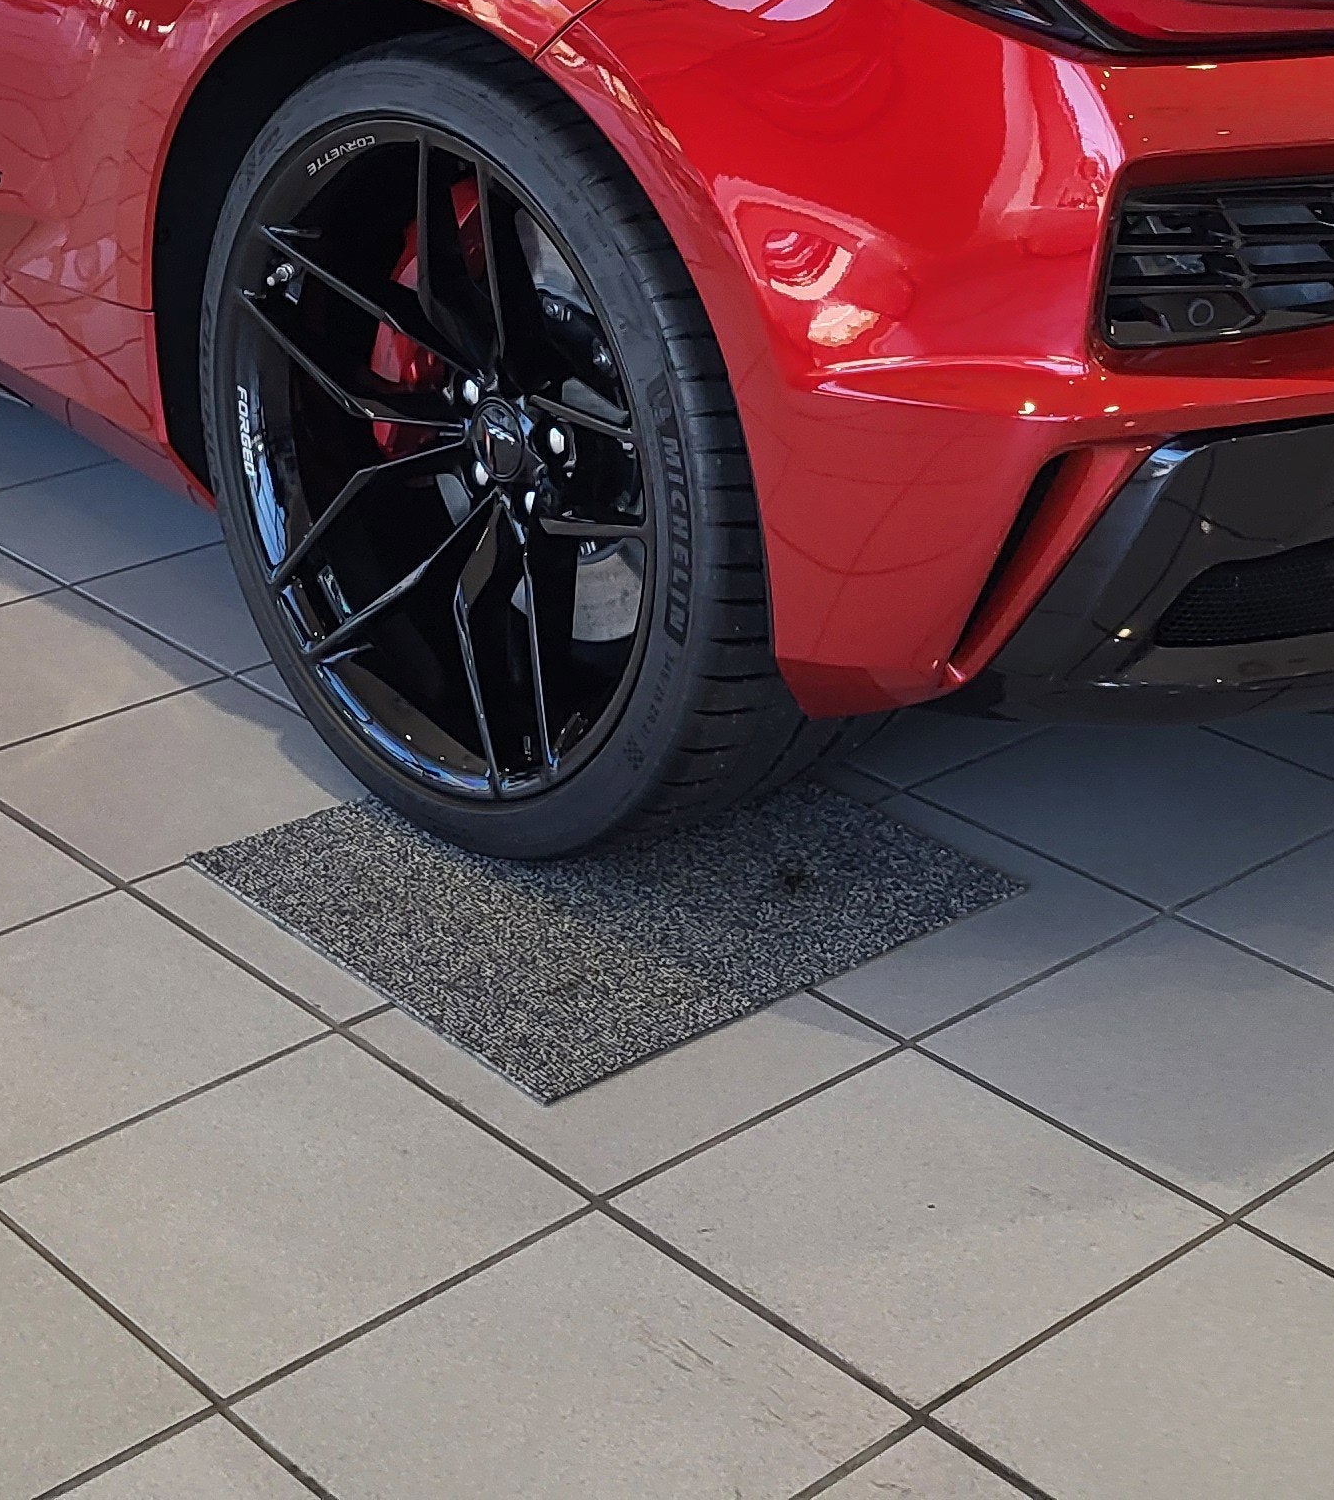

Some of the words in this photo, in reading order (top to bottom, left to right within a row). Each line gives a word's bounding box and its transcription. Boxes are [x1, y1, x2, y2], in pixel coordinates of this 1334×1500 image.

[306, 135, 376, 177] CORVETTE
[236, 385, 255, 477] FORGED
[661, 435, 690, 635] MICHELIN
